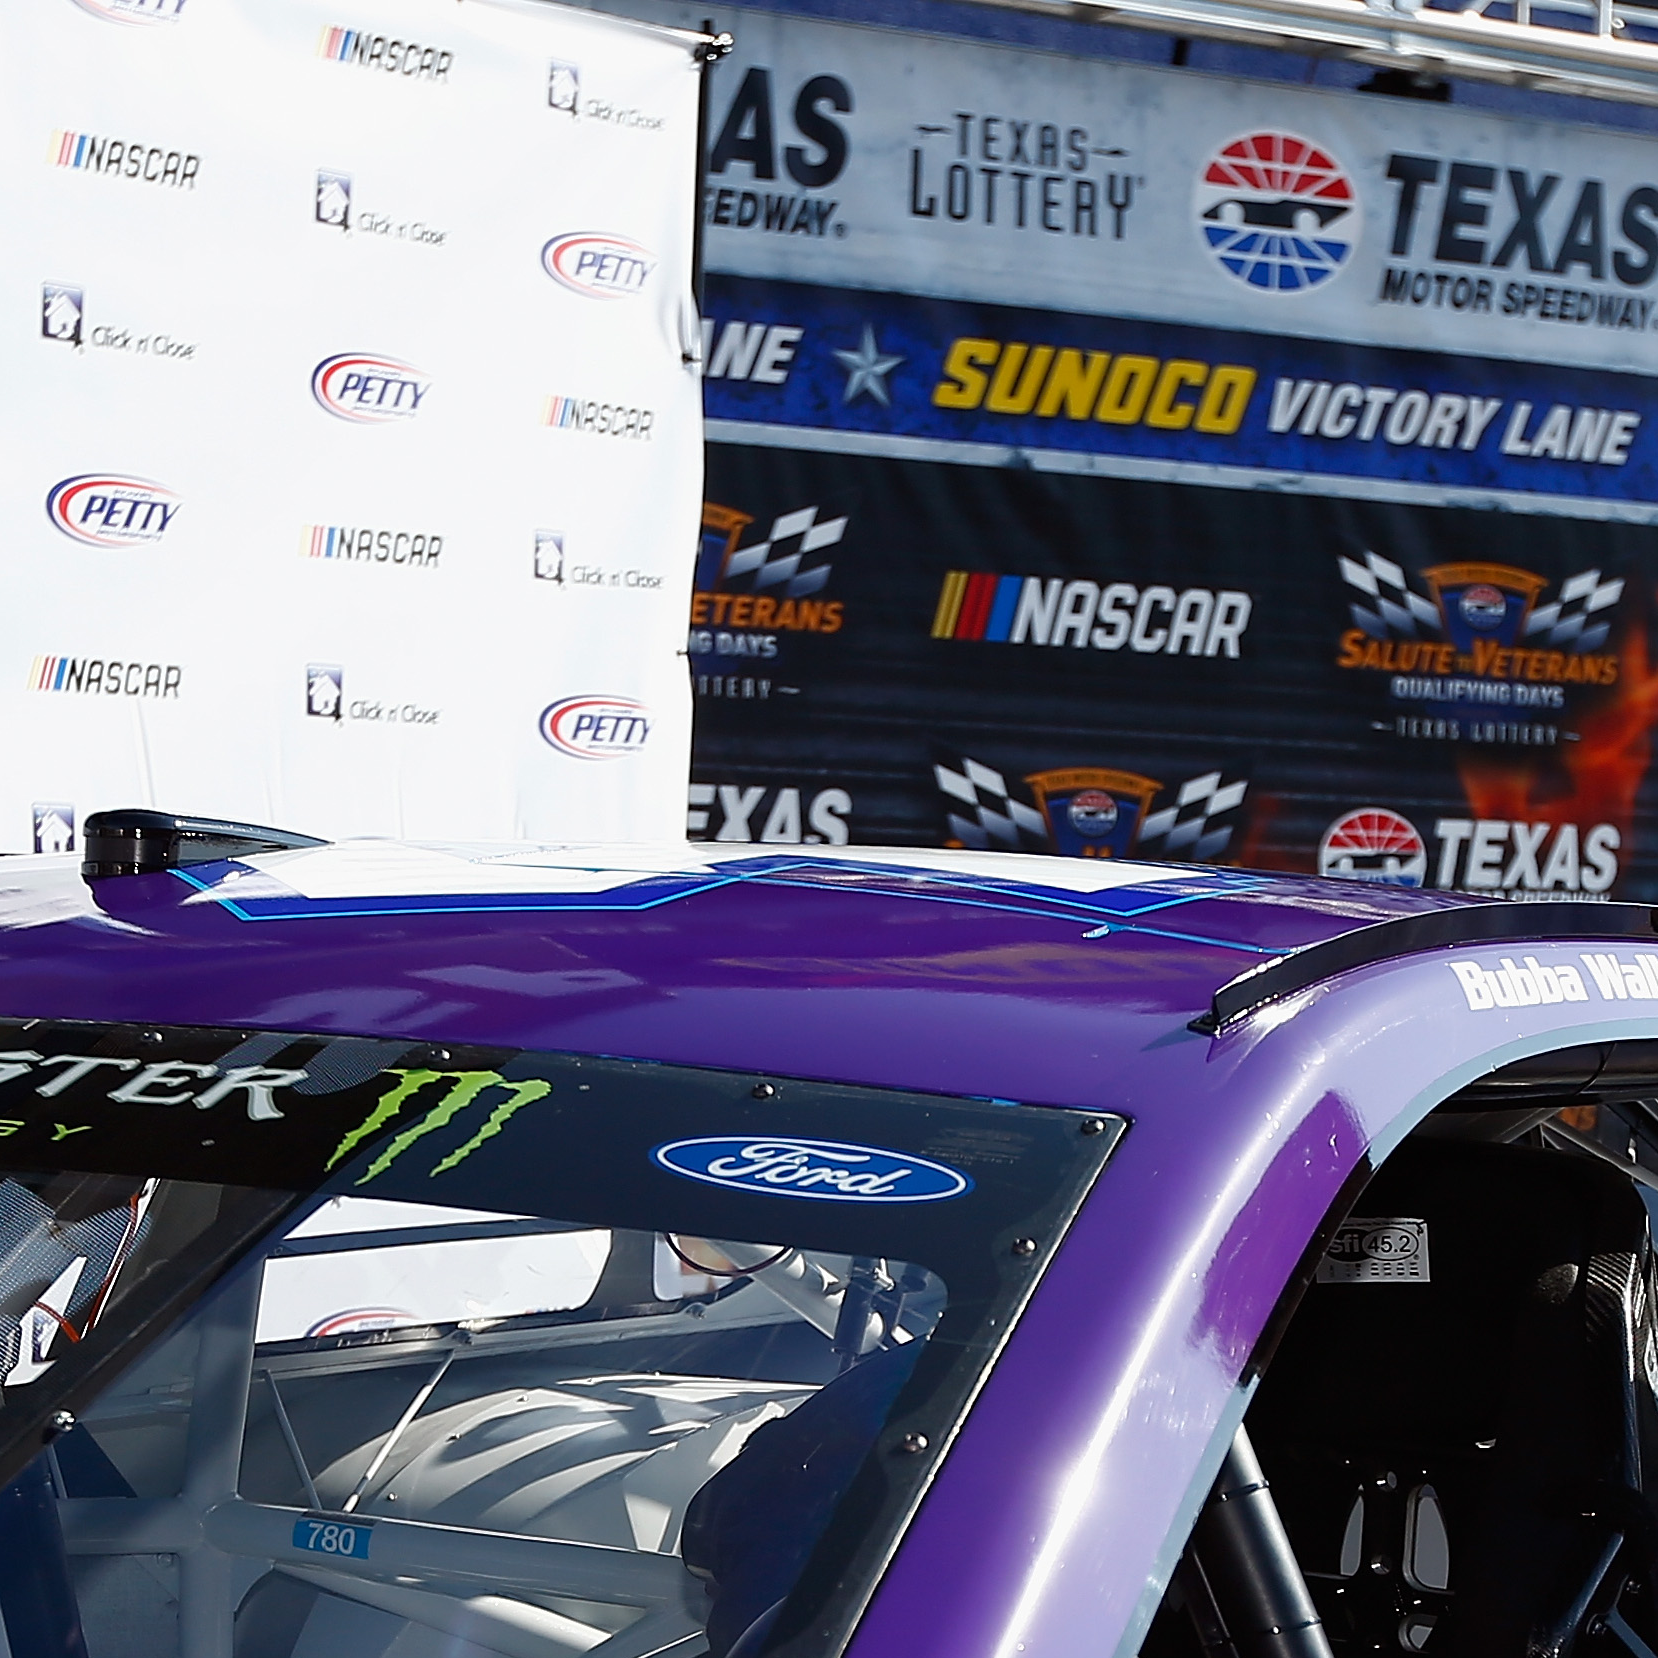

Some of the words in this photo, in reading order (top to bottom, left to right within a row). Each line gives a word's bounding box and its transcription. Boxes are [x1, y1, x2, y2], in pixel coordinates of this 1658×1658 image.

[86, 137, 199, 189] NASCAR
[953, 112, 1089, 172] TEXAS
[706, 187, 840, 237] EDWAY
[908, 148, 1137, 240] LOTTERY
[574, 251, 656, 287] PETTY
[1381, 268, 1492, 314] MOTOR
[1502, 282, 1658, 332] SPEEDWAY
[338, 373, 433, 409] PETTY
[933, 337, 1257, 435] SUNOCO
[1269, 378, 1501, 451] VICTORY
[1501, 401, 1640, 466] LANE
[80, 494, 181, 532] PETTY
[338, 528, 442, 567] NASCAR
[1009, 577, 1252, 660] NASCAR
[716, 632, 778, 657] DAYS
[1337, 629, 1455, 676] SALUTE
[1473, 639, 1618, 686] VETERANS
[66, 659, 181, 698] NASCAR
[1390, 676, 1512, 706] QUALIFYING
[1513, 683, 1565, 709] DAYS
[572, 714, 655, 744] PETTY
[1433, 819, 1621, 891] TEXAS
[1449, 955, 1589, 1011] Bubba
[706, 1141, 912, 1198] Ford
[1367, 1236, 1412, 1254] 45.2
[308, 1522, 356, 1555] 780
